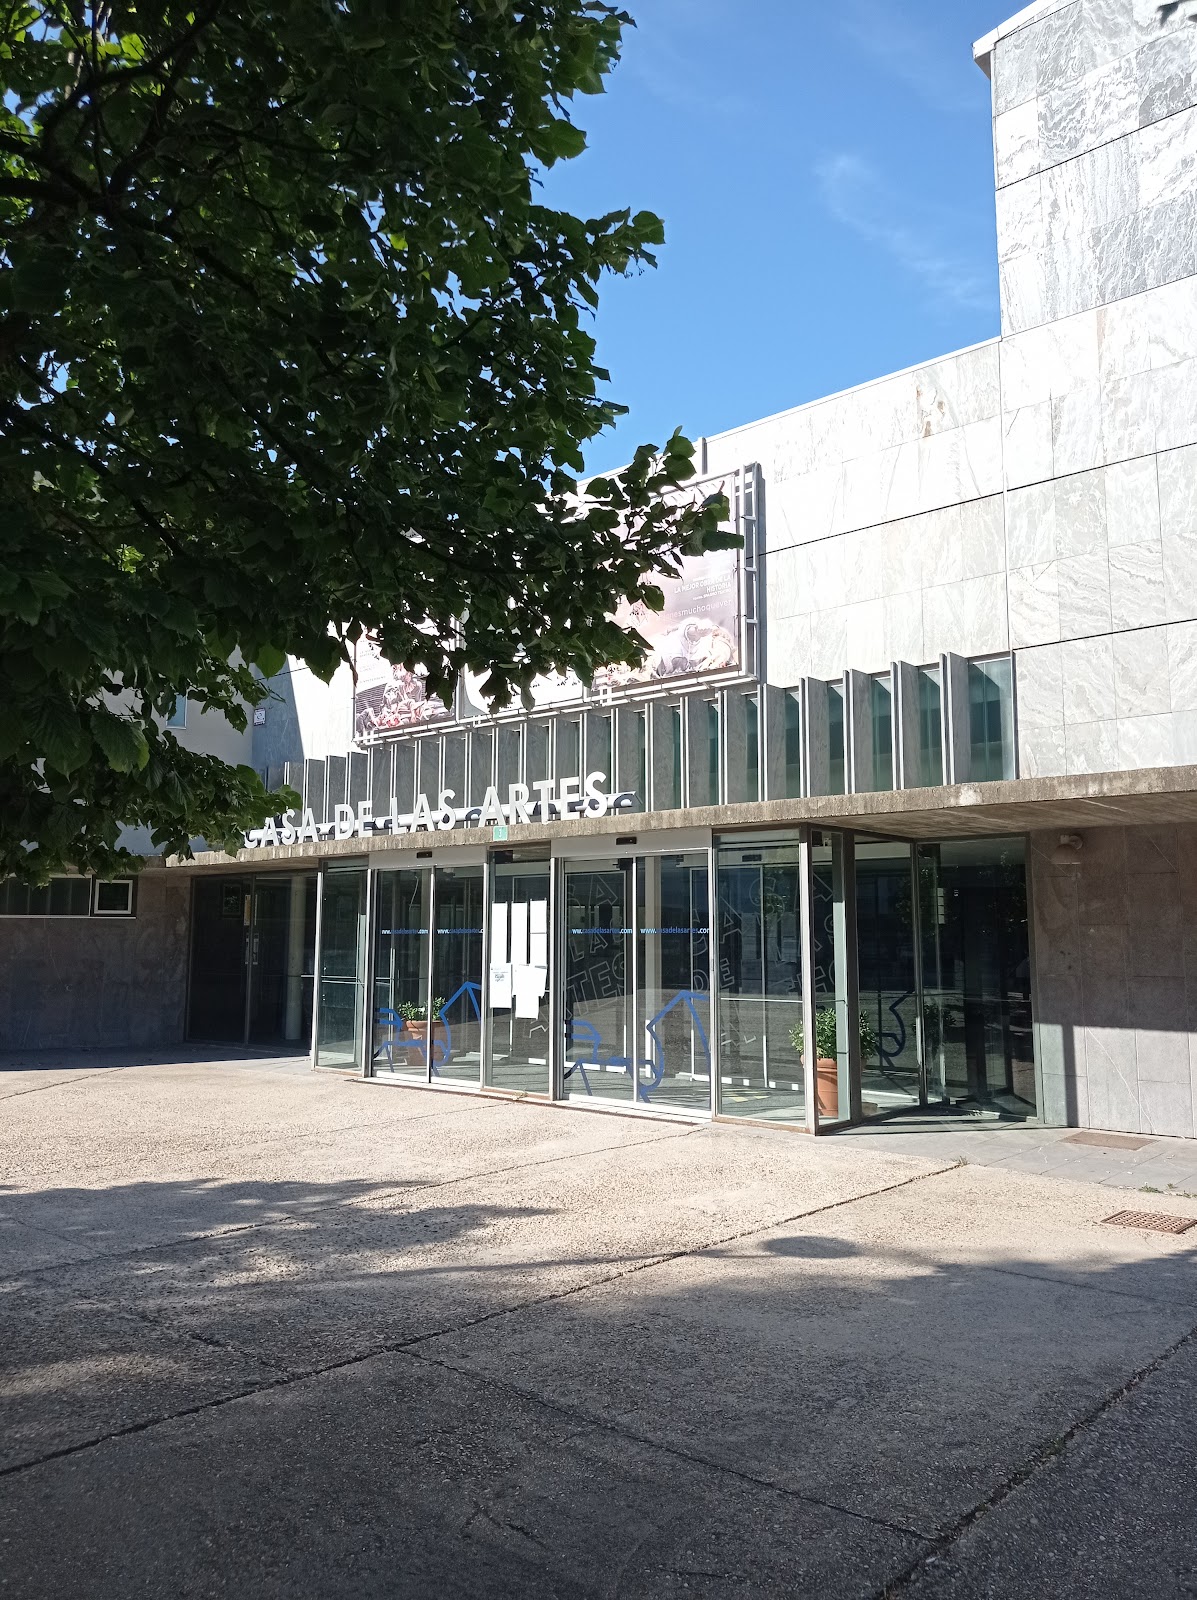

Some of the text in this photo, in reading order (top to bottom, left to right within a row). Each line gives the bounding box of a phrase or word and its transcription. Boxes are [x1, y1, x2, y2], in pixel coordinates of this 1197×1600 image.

[335, 800, 373, 841] DE
[390, 788, 456, 835] LAS
[478, 771, 608, 827] ARTES
